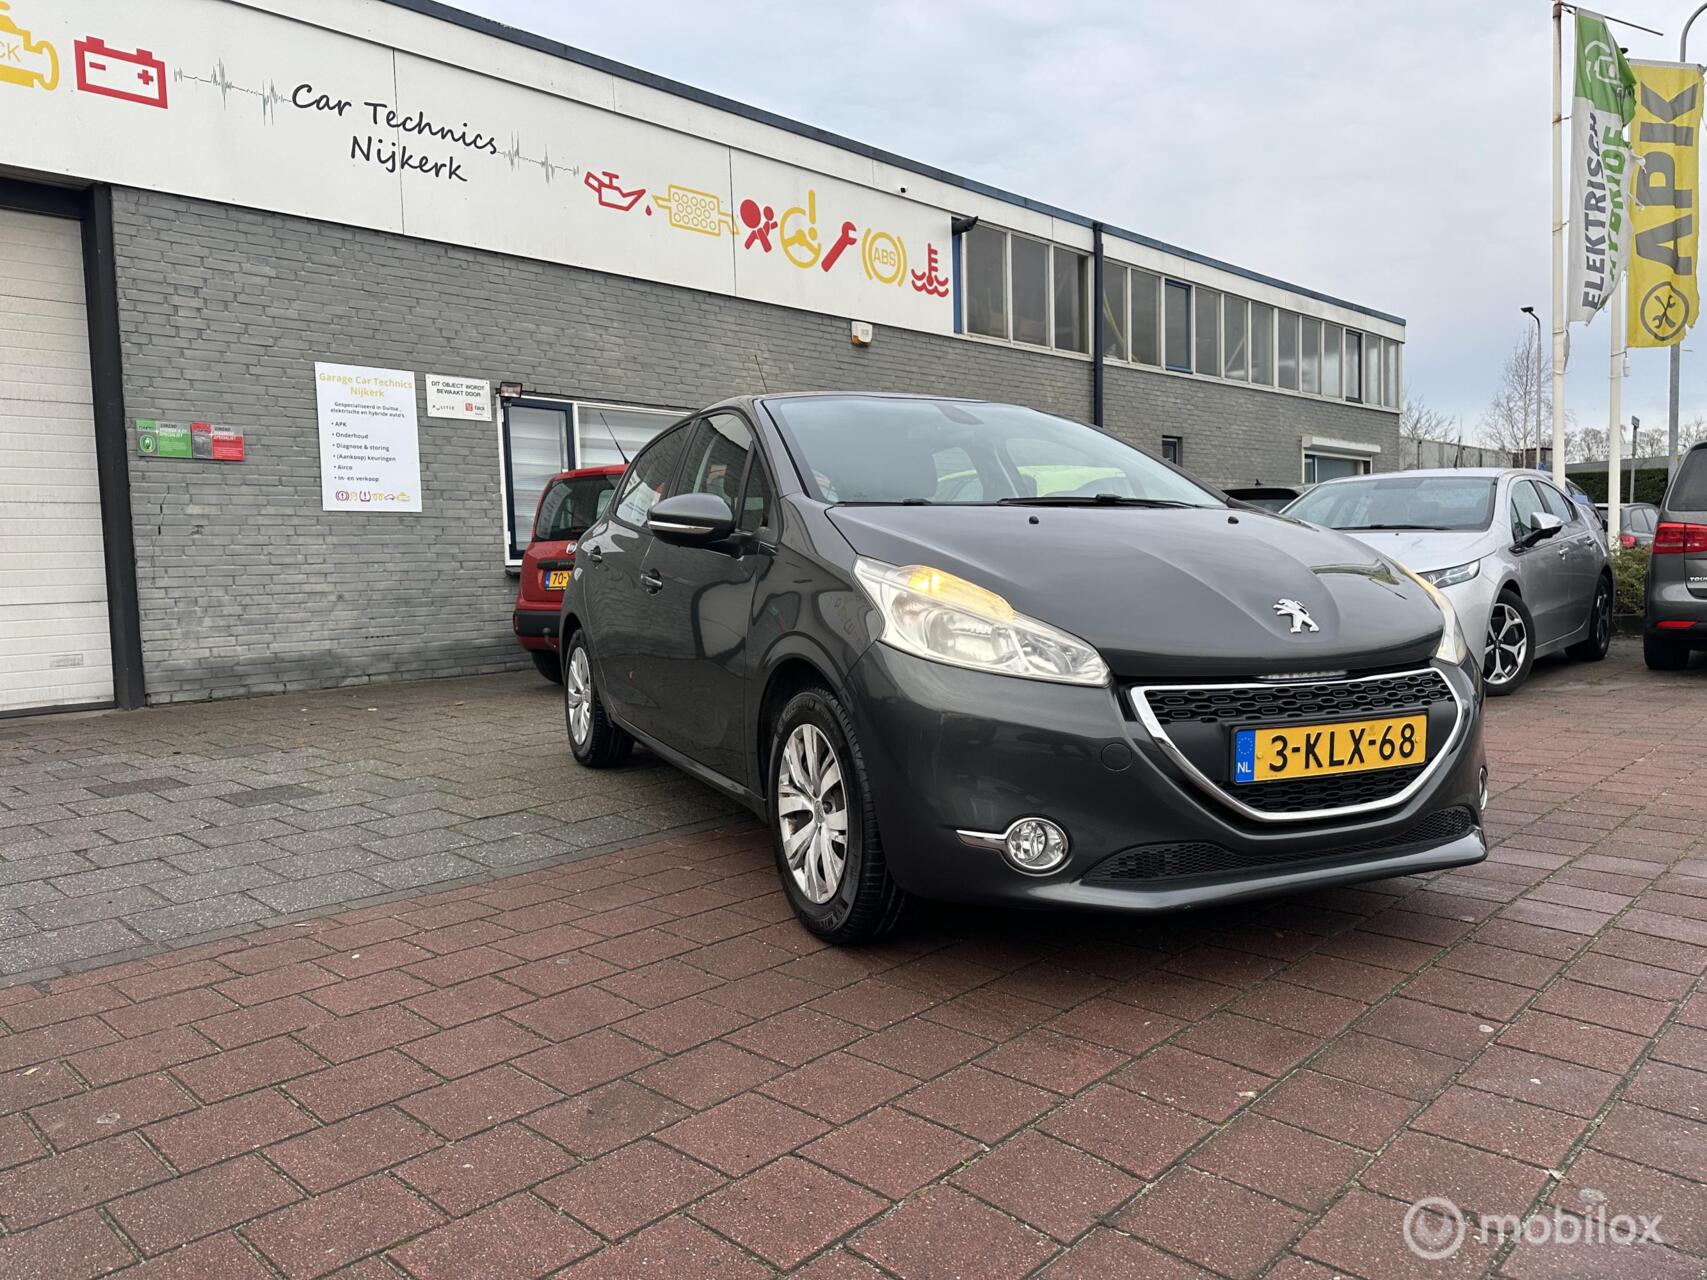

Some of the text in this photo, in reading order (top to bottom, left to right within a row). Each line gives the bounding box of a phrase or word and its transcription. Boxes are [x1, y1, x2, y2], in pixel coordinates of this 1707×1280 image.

[291, 84, 497, 155] Car Technics
[350, 135, 468, 182] Nijkerk
[1635, 81, 1698, 276] APK
[874, 247, 897, 268] ABS
[319, 372, 413, 389] Garage Car Technics
[350, 387, 385, 398] Nijkerk
[336, 443, 363, 451] Diagnose
[367, 455, 397, 463] keuringen
[355, 475, 380, 483] verkoop
[1268, 723, 1416, 772] 3-KLX-68
[1237, 761, 1252, 774] NL
